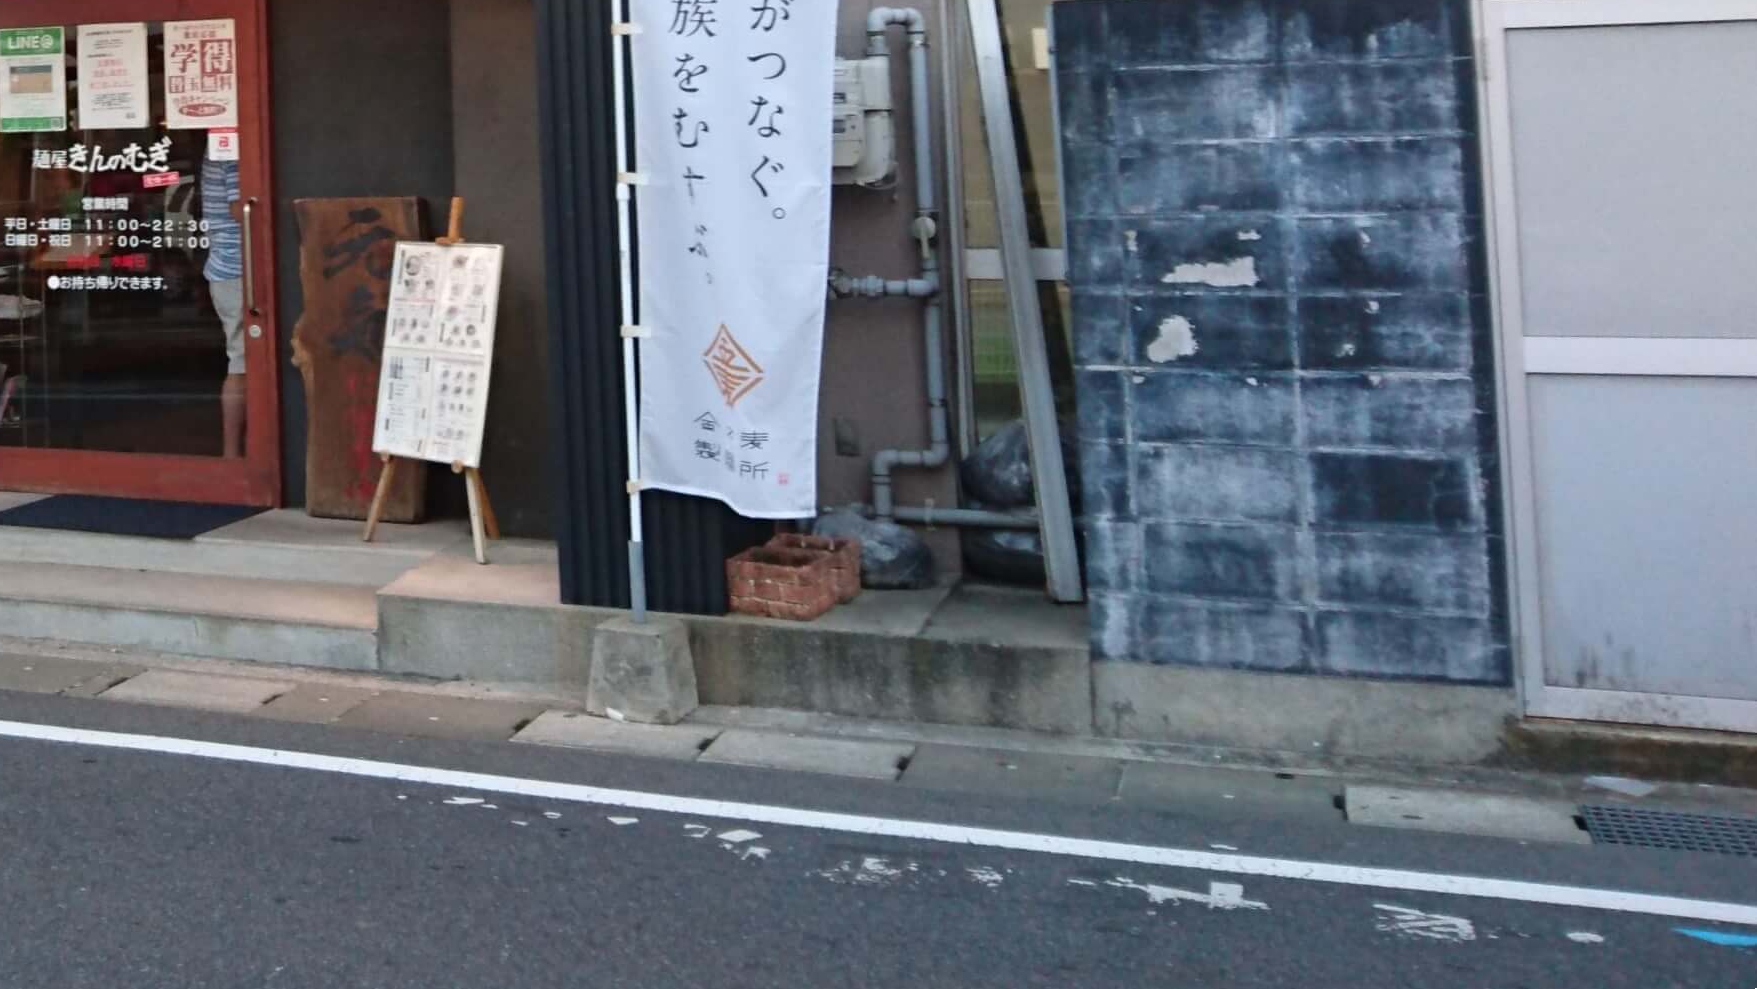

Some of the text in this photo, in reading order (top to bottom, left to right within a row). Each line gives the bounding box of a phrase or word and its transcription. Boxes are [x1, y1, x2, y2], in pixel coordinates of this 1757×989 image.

[33, 136, 172, 172] 麺屋きんのむぎ
[81, 197, 129, 211] 営業時間
[694, 411, 769, 449] 金麦
[695, 439, 769, 480] 製所
